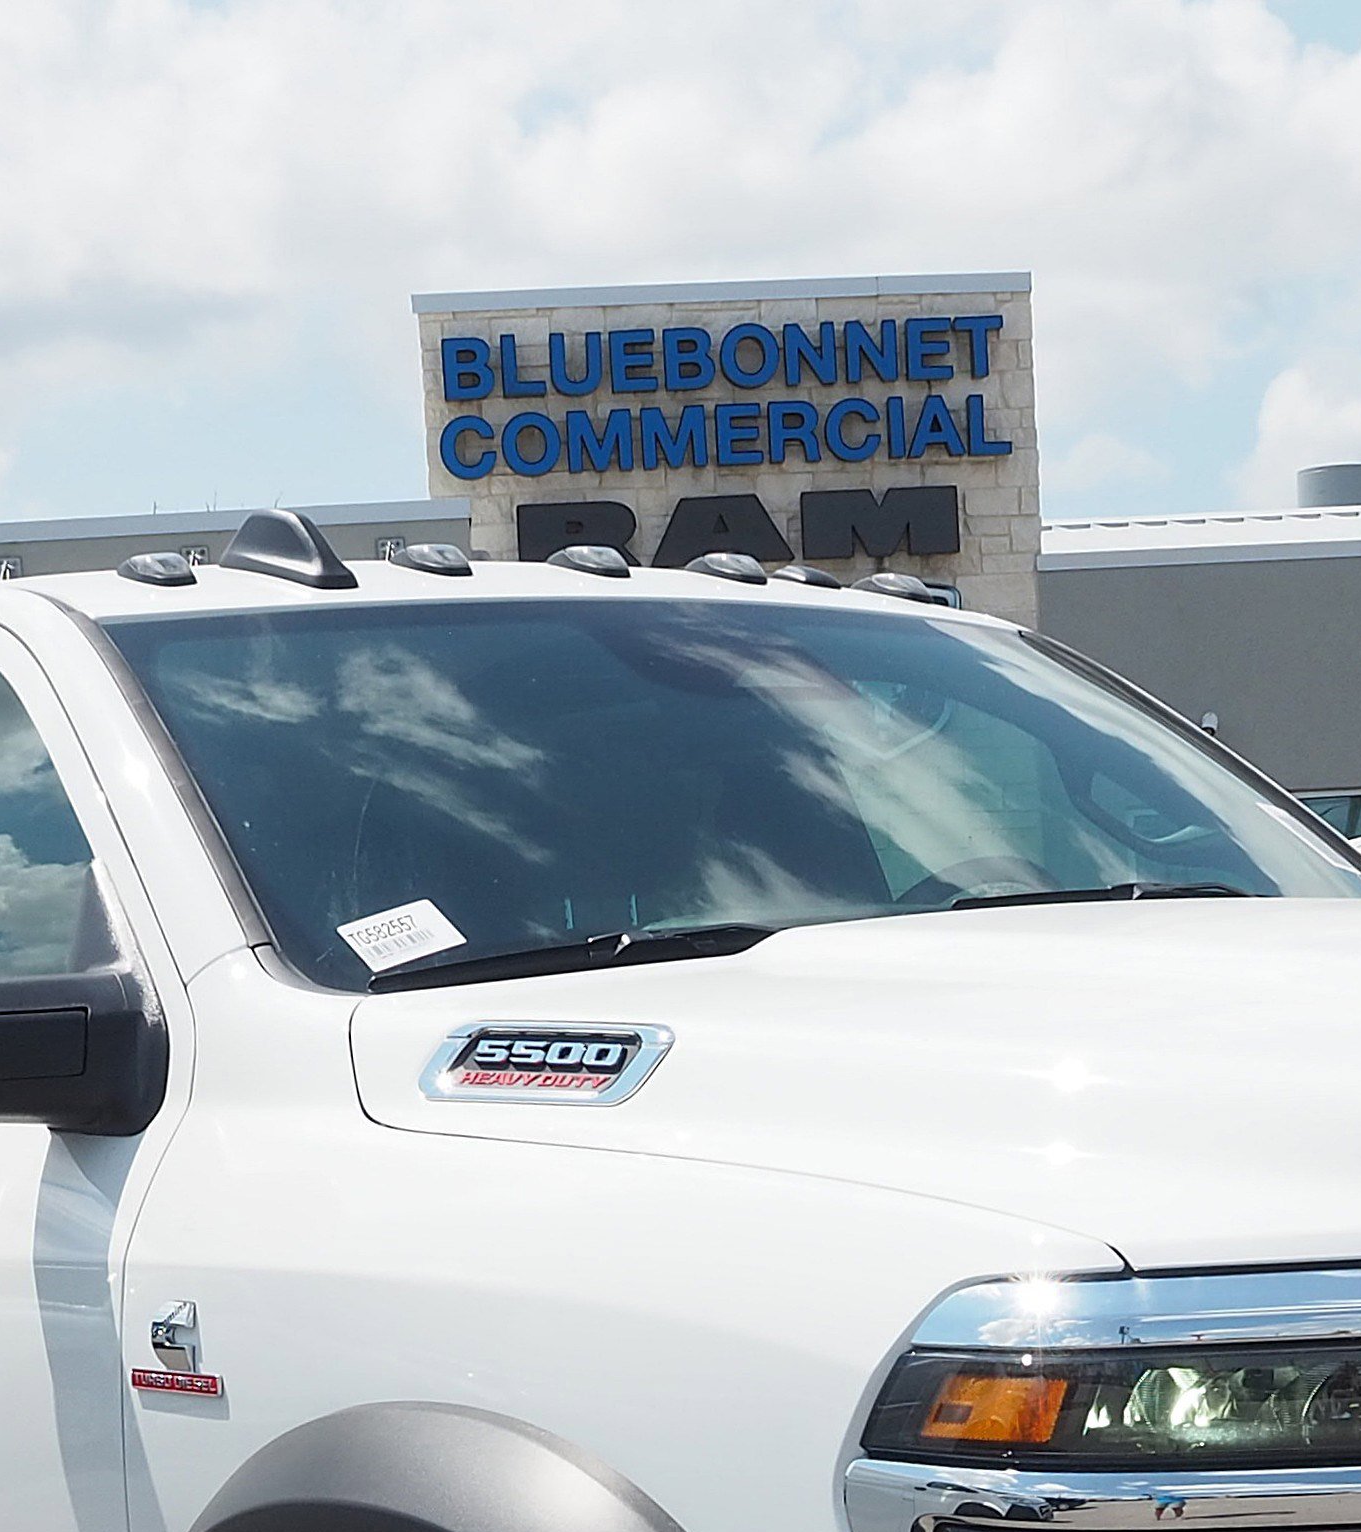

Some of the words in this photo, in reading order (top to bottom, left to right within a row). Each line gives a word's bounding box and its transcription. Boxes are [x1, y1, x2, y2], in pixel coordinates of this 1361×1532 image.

[441, 314, 1003, 401] BLUEBONNET
[439, 394, 1013, 480] COMMERCIAL
[516, 484, 961, 567] RAM
[461, 1072, 538, 1086] HEAVY
[537, 1074, 611, 1089] DUTY
[474, 1039, 626, 1072] 5500
